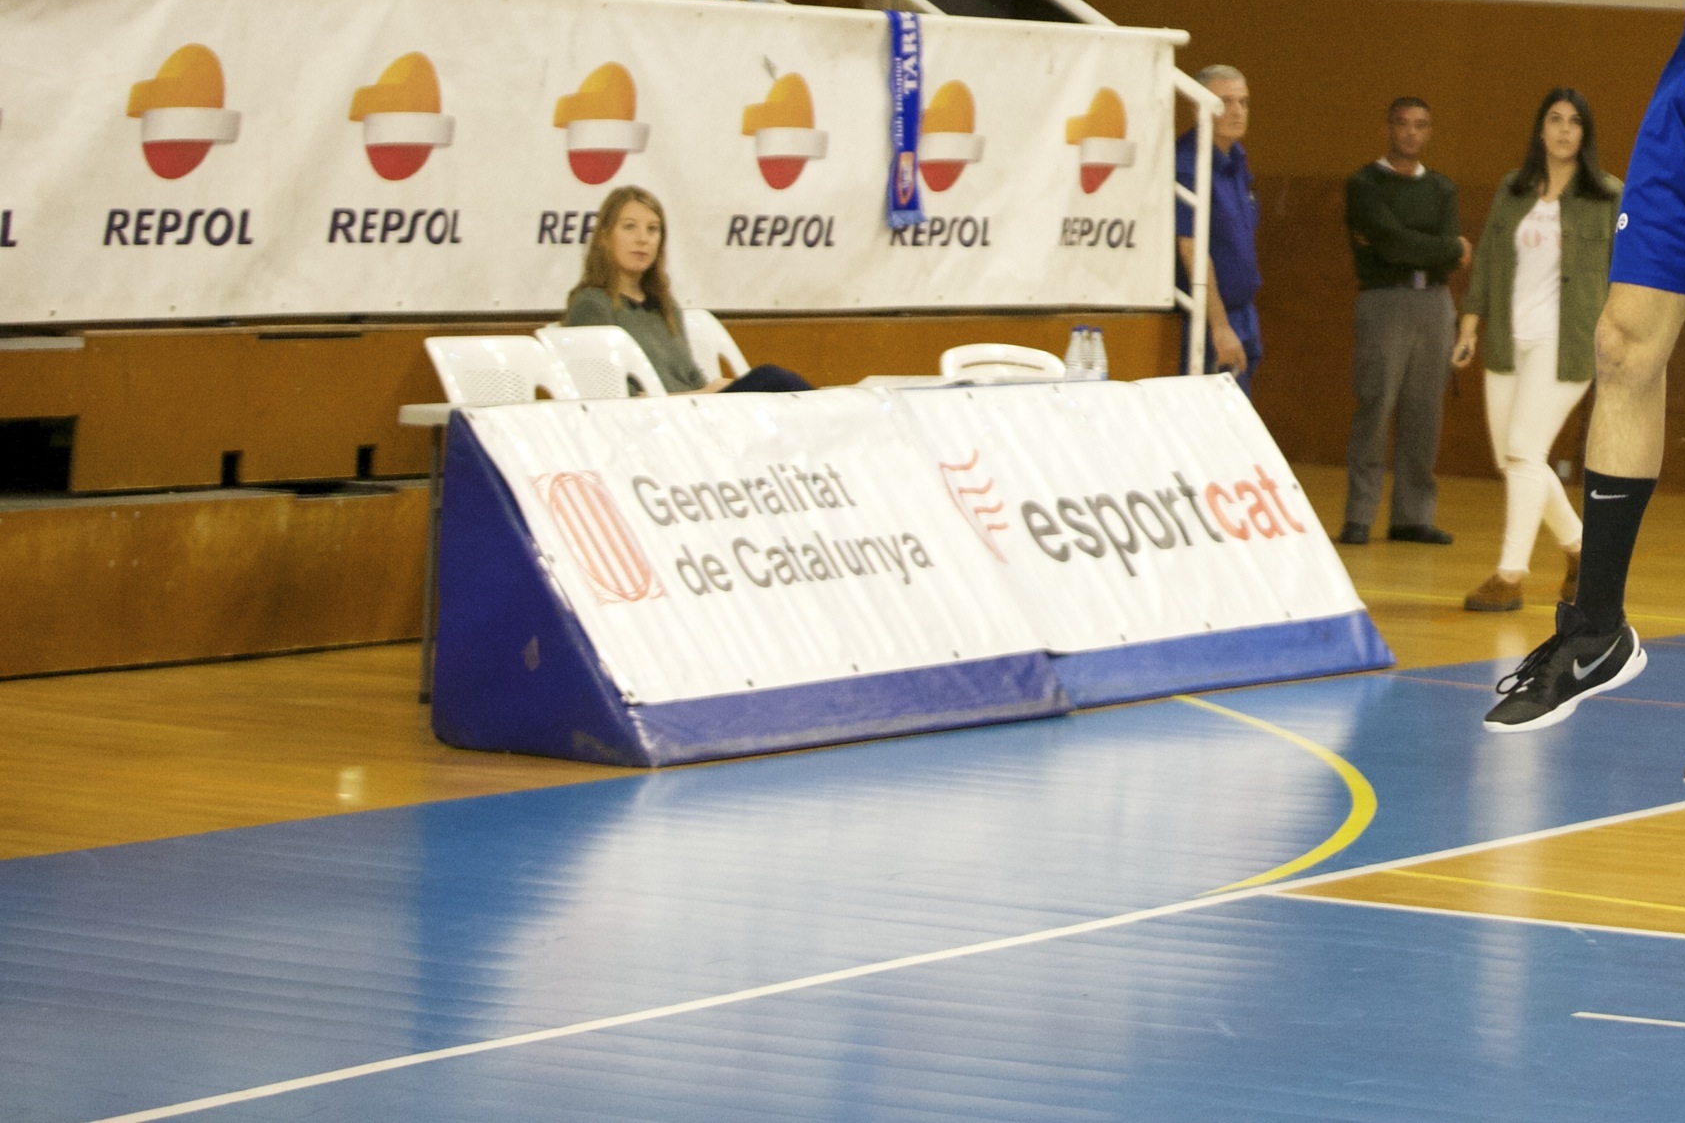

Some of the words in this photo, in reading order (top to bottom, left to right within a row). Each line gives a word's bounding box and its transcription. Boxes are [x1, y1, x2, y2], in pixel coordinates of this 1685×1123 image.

[103, 208, 254, 246] REPSOL
[326, 208, 462, 245] REPSOL
[726, 214, 836, 247] REPSOL
[1058, 217, 1136, 249] REPSOL
[633, 463, 857, 527] Generalitat
[1021, 464, 1307, 577] esportcat
[676, 544, 733, 595] de
[732, 531, 934, 585] Catalunya
